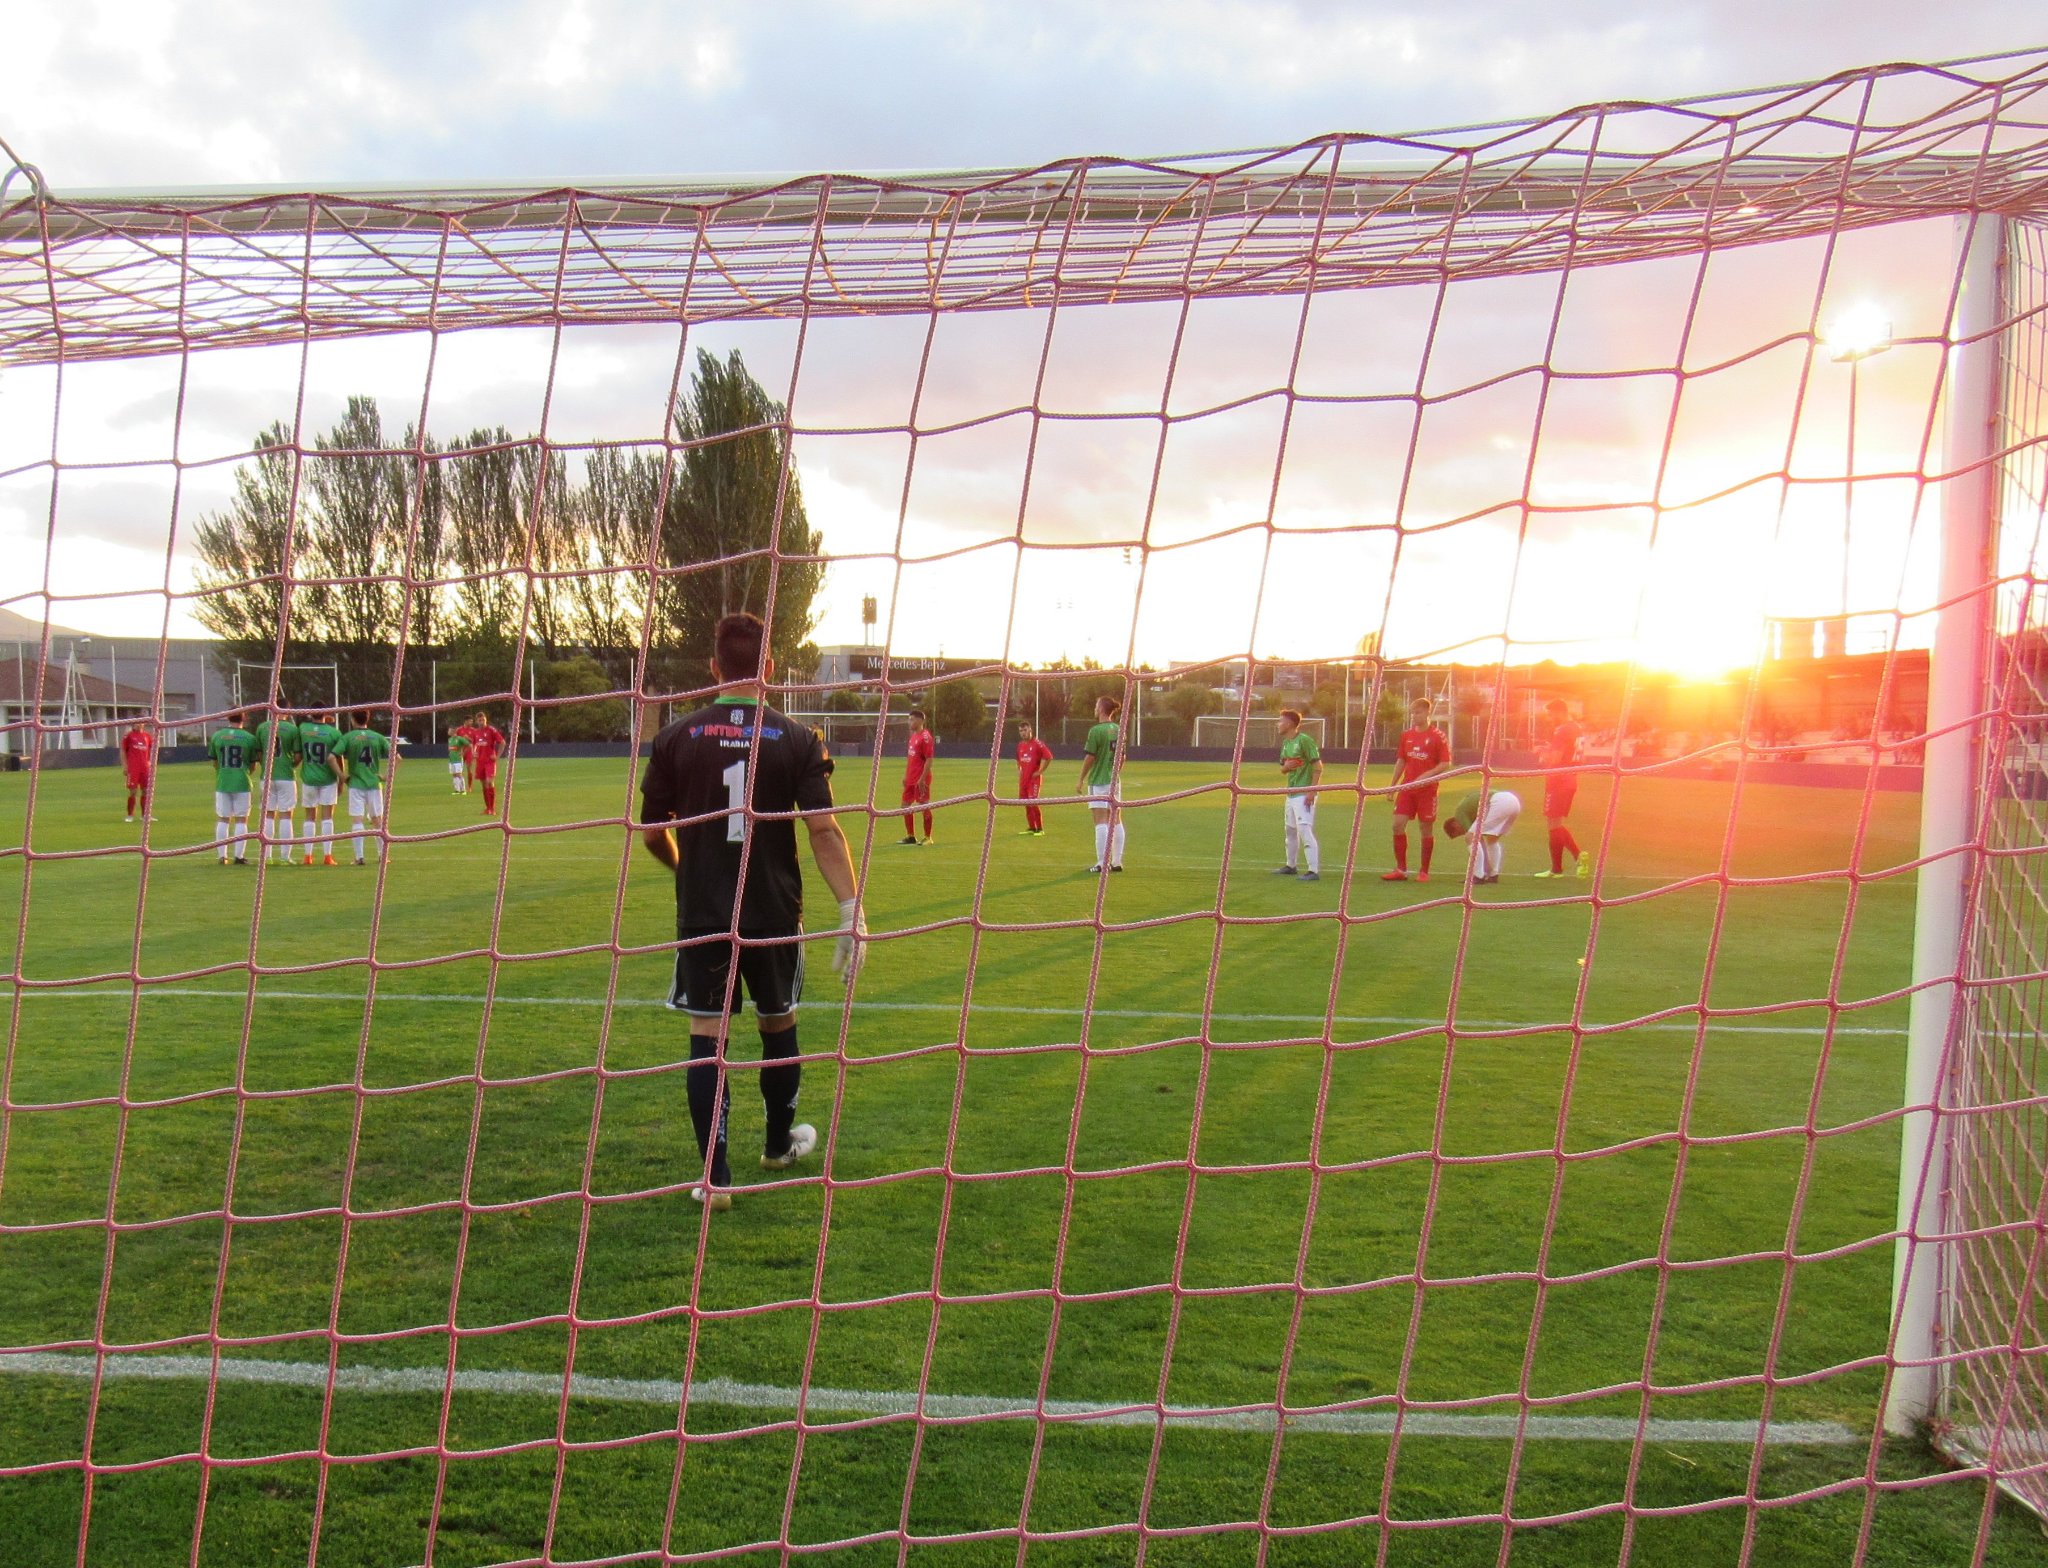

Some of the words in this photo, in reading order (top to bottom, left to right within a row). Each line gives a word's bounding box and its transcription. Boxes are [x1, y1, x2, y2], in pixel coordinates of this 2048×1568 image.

[867, 656, 945, 671] Mecedes-Benz
[704, 724, 783, 741] INTERSORT
[220, 745, 244, 769] 18
[303, 742, 327, 766] 19
[358, 745, 373, 768] 4
[723, 760, 746, 842] 1
